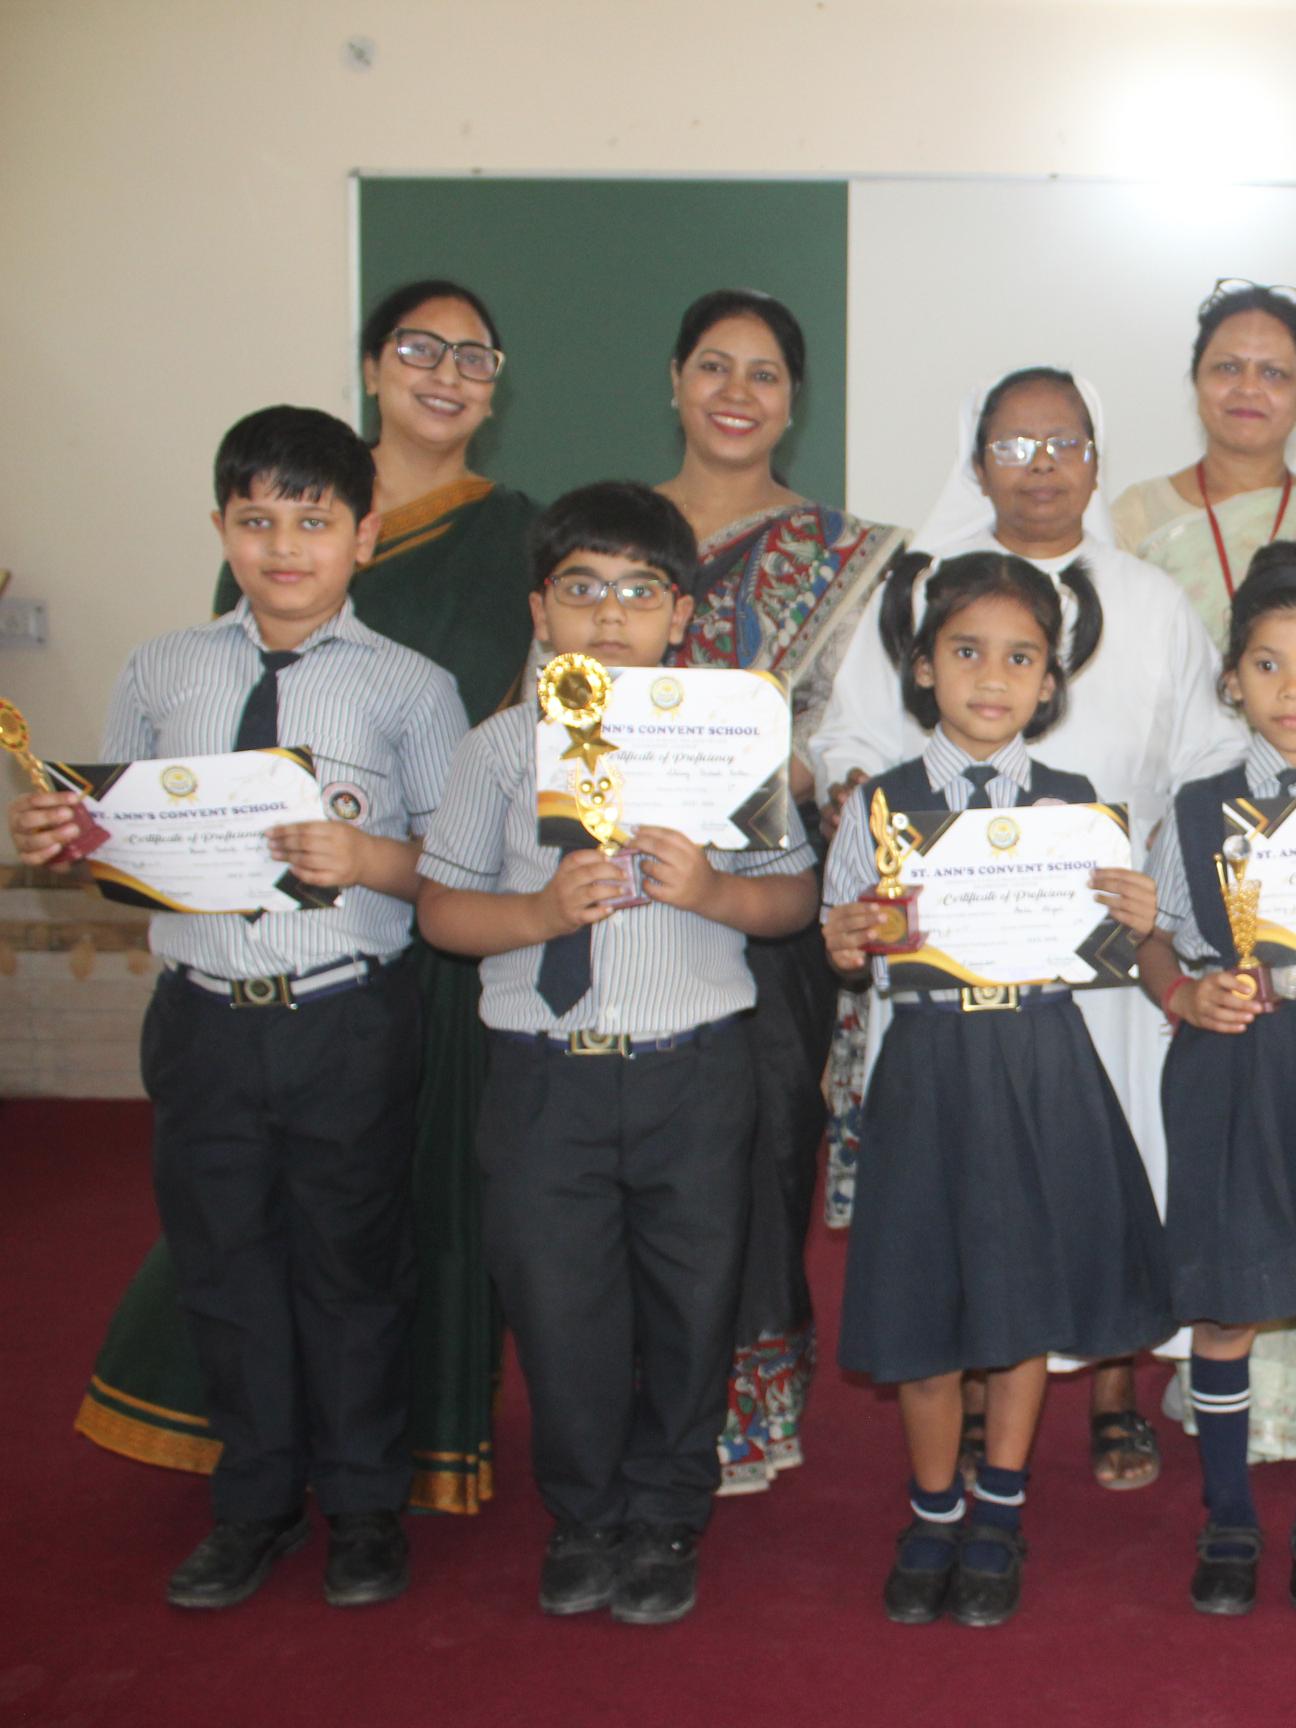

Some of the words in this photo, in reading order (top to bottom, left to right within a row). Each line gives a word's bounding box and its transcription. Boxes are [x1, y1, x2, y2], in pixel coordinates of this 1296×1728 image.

[602, 723, 635, 734] NN'S
[638, 724, 705, 735] CONVENT
[708, 726, 760, 736] SCHOOL
[606, 750, 655, 766] ertificate
[673, 750, 735, 765] Proficiency
[113, 811, 156, 821] ANN'S
[158, 807, 227, 820] CONVENT
[231, 801, 289, 815] SCHOOL
[127, 831, 184, 846] Certificate
[1256, 850, 1277, 860] ST.
[910, 868, 930, 879] ST.
[934, 865, 975, 878] ANN'S
[978, 862, 1043, 876] CONVENT
[1046, 860, 1098, 872] SCHOOL
[942, 890, 997, 907] Certificate
[1013, 886, 1076, 902] Proficiency
